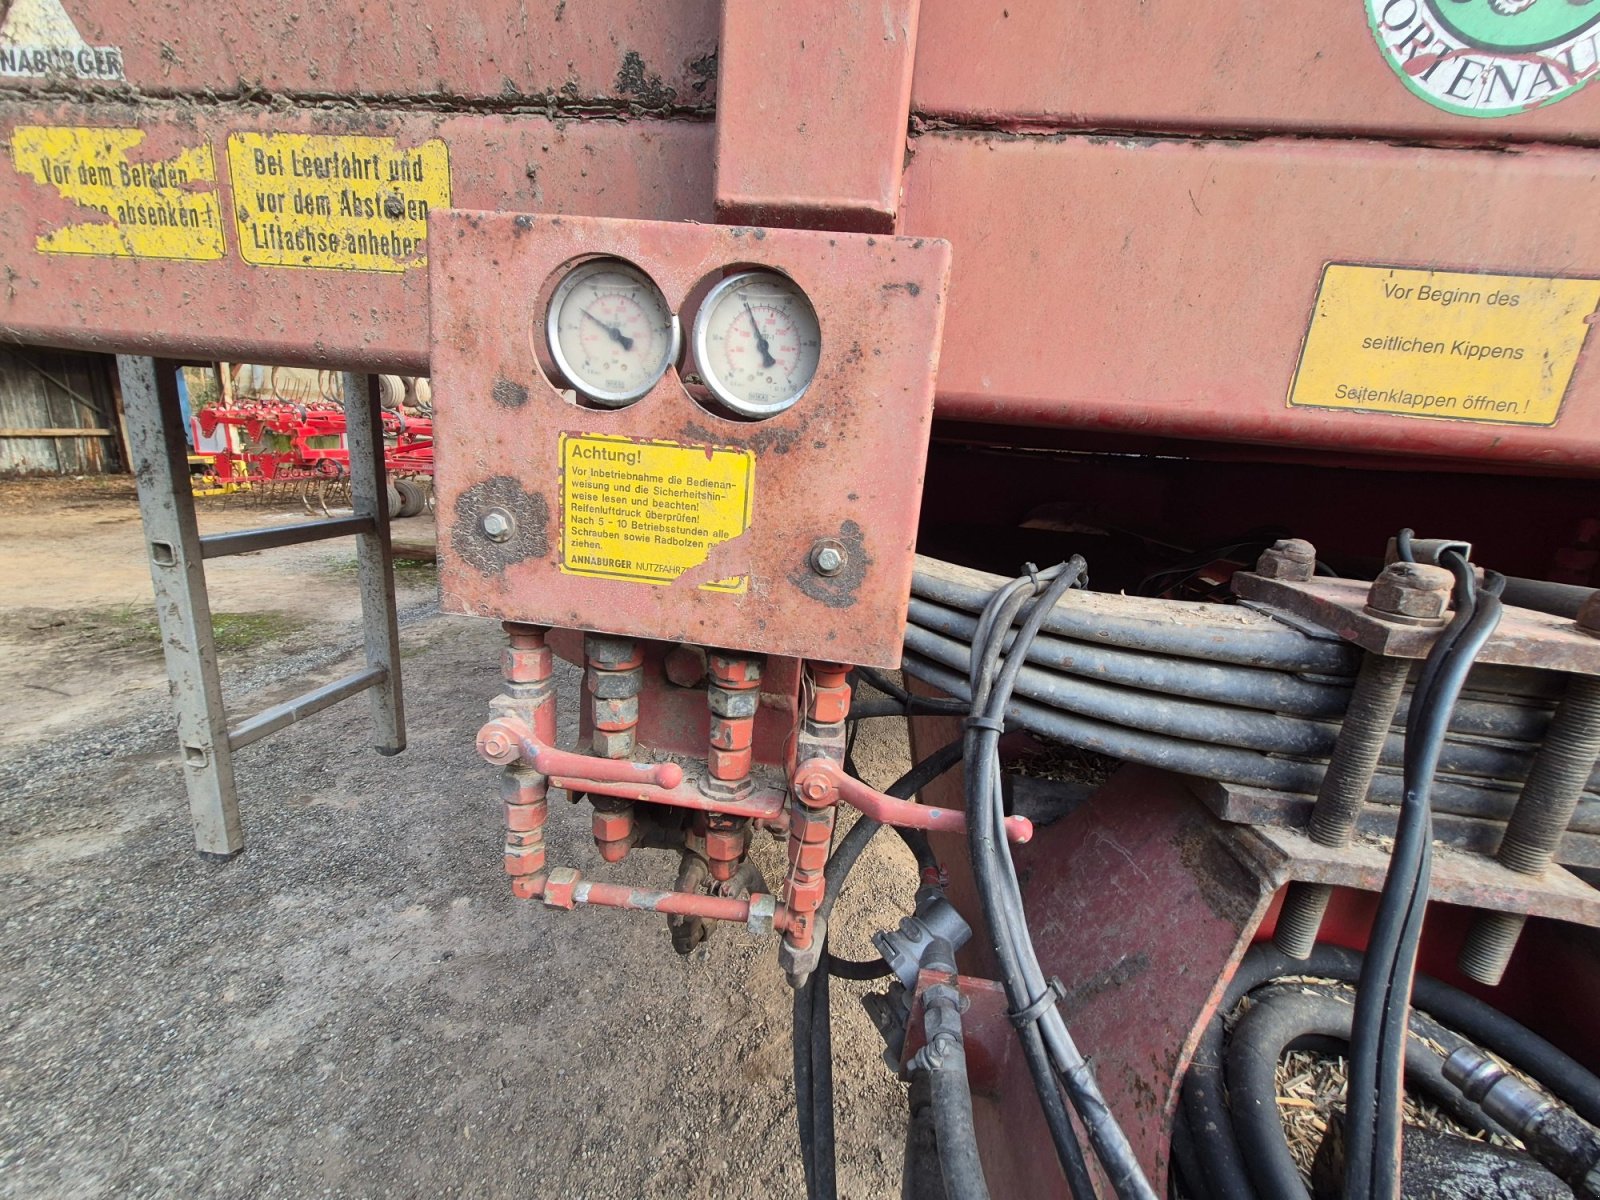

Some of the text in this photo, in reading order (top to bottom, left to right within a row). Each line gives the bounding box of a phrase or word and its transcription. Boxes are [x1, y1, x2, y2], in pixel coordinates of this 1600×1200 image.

[41, 158, 189, 188] Vor dem Beladen
[254, 148, 424, 182] Bei Leerfahrt und
[117, 199, 200, 228] absenken
[256, 190, 285, 213] vor
[293, 188, 331, 216] dem
[1383, 283, 1520, 308] Vor Beginn des
[1362, 336, 1524, 361] seitlichen Kippens
[1334, 384, 1457, 409] Seitenklappen
[571, 444, 641, 466] Achtung!
[571, 466, 736, 490] Vor Inbetriebnahme die Bedienan-
[571, 480, 726, 502] weisung und die Sicherheitshin-
[571, 491, 699, 512] weise lesen und beachten!
[571, 502, 700, 525] Reifenluftdruck überprüfen!
[570, 515, 594, 525] Nach
[598, 517, 604, 527] 5
[617, 519, 628, 529] 10
[631, 521, 709, 537] Betriebsstunden
[712, 530, 729, 539] alle
[571, 526, 620, 540] Schrauben
[623, 532, 650, 543] sowie
[654, 534, 704, 549] Radbolzen
[570, 539, 603, 550] ziehen.
[571, 553, 632, 569] ANNABURGER
